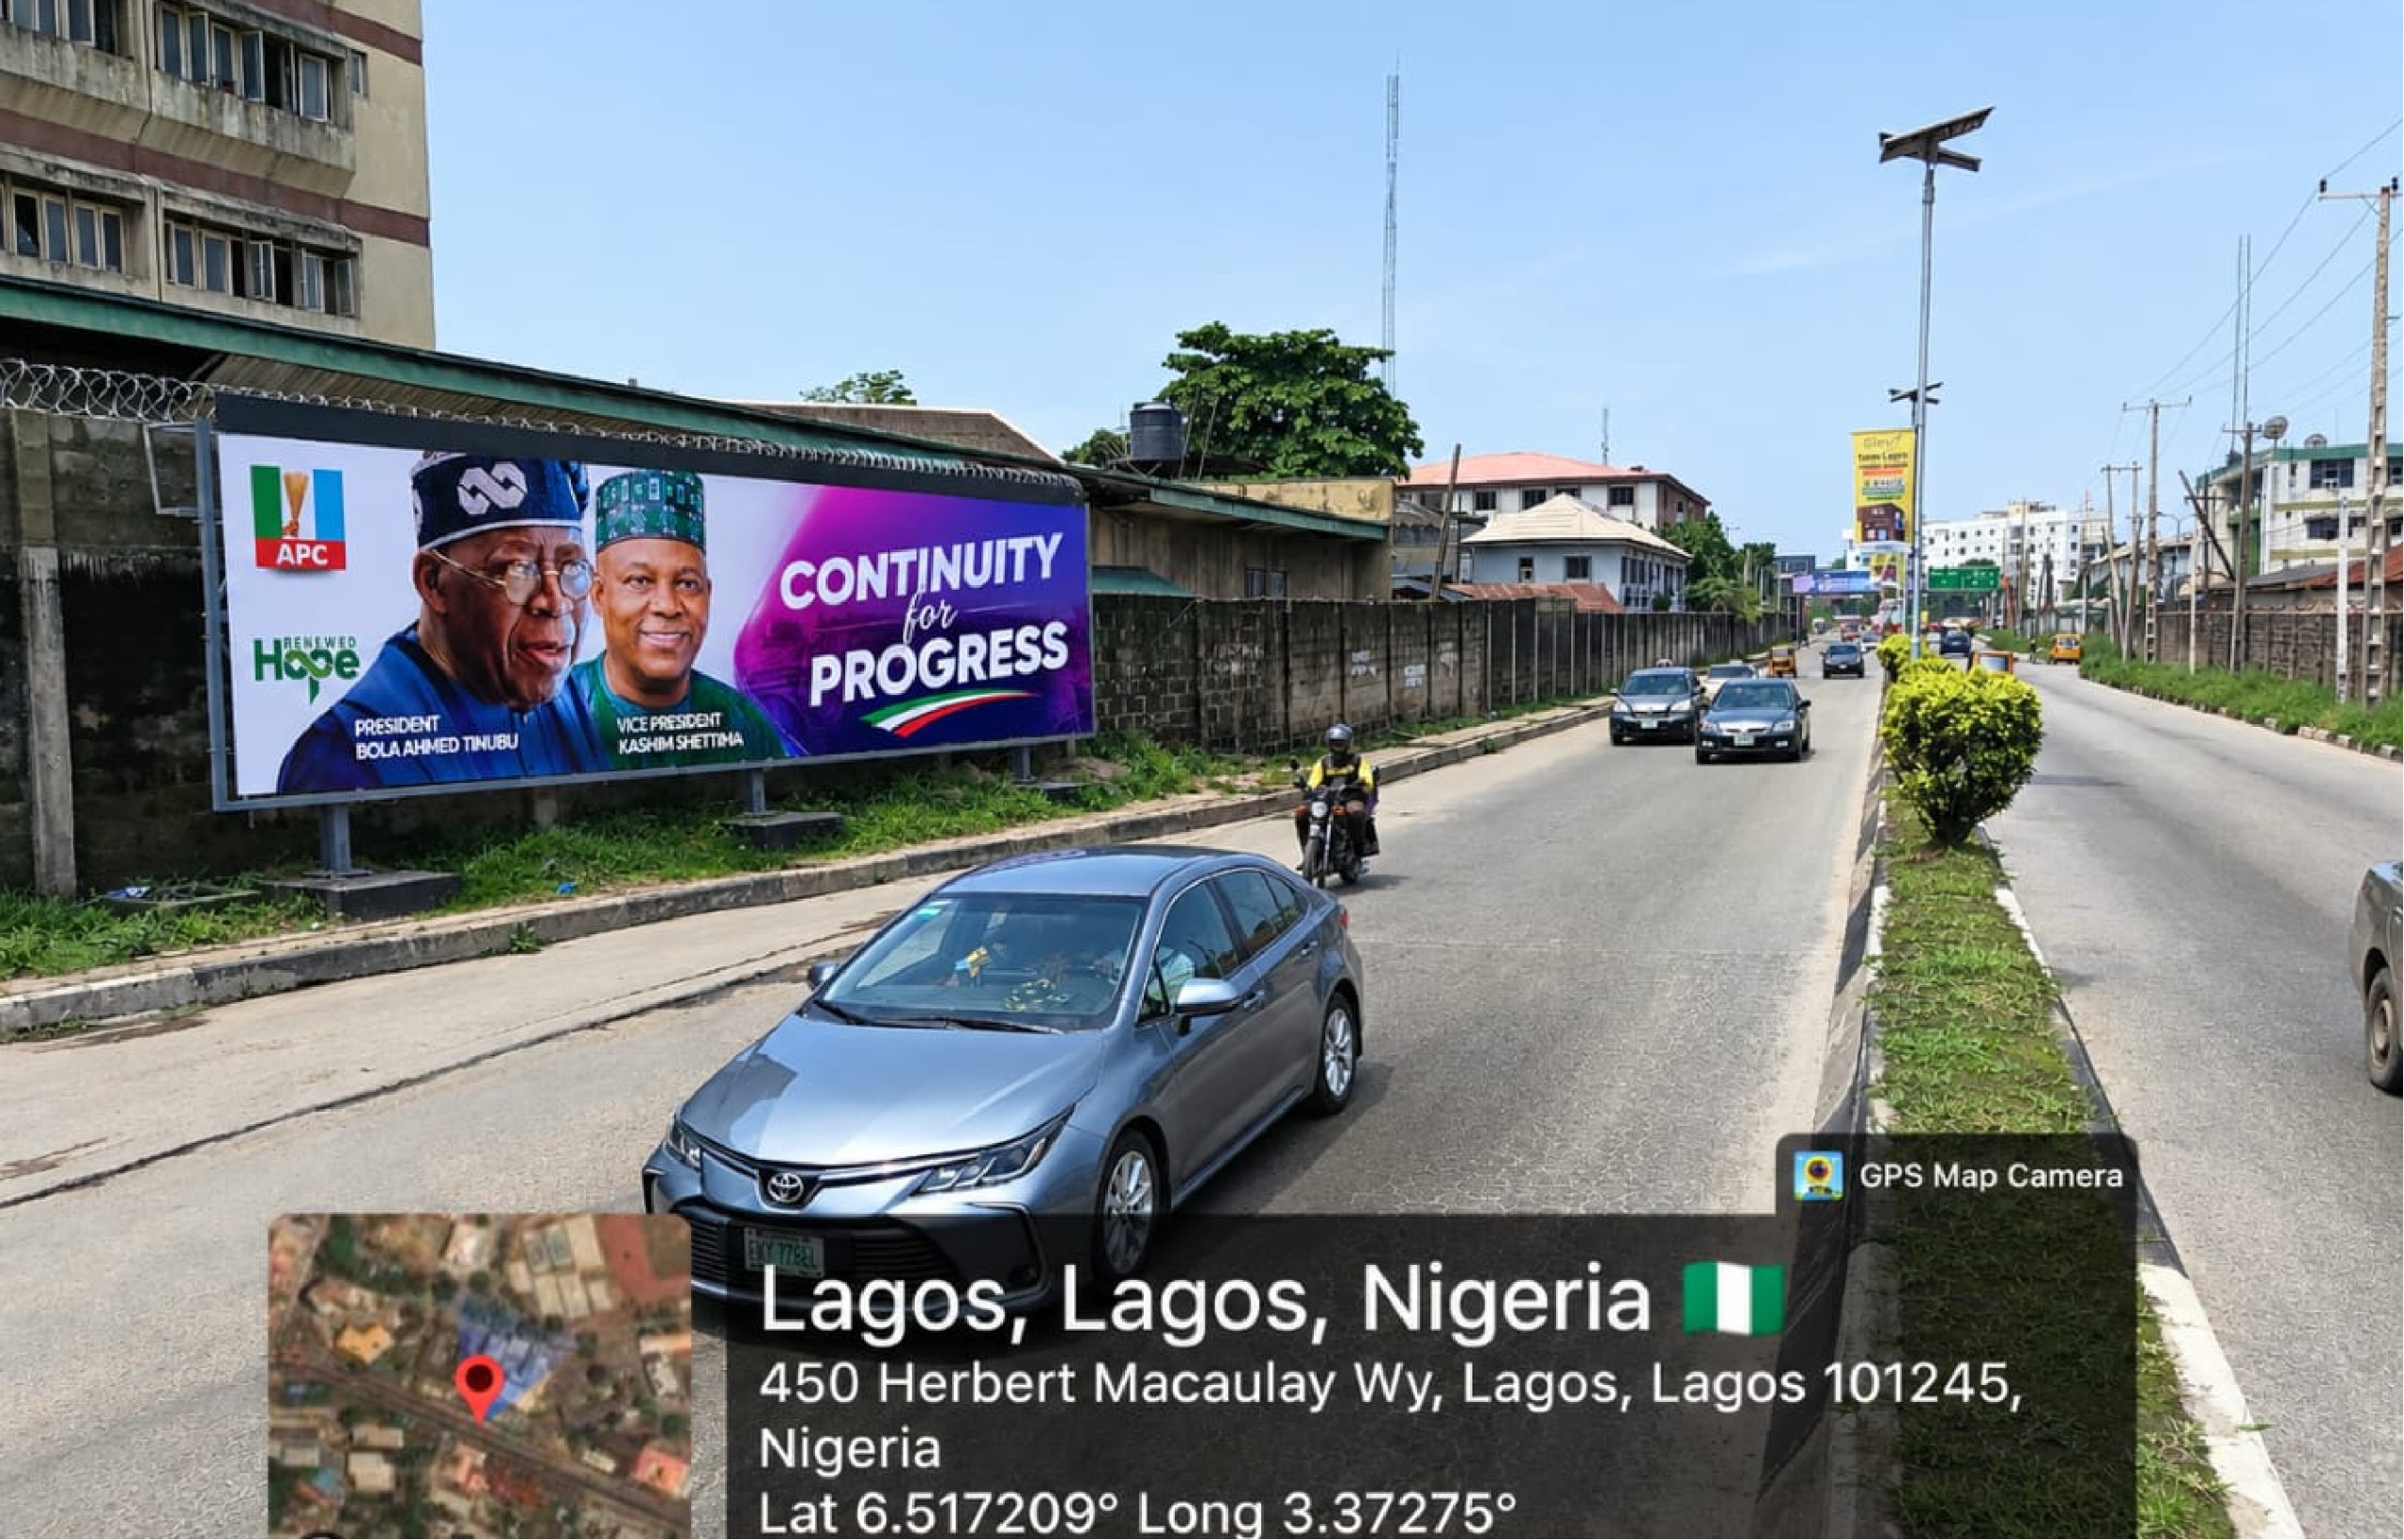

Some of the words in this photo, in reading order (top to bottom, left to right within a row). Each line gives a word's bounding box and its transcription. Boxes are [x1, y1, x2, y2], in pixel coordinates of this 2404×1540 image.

[276, 543, 329, 566] APC
[780, 532, 1063, 610] CONTINUITY
[902, 591, 959, 645] for
[284, 636, 357, 649] RENEWED
[254, 638, 361, 705] Hope
[809, 621, 1069, 707] PROGRESS
[355, 715, 441, 737] PRESIDENT
[617, 716, 649, 733] VICE
[650, 712, 722, 732] PRESIDENT
[356, 739, 401, 761] BOLA
[403, 736, 460, 756] AHMED
[462, 732, 519, 752] TINUBU
[619, 734, 674, 755] KASHIM
[675, 730, 745, 750] SHETTIMA
